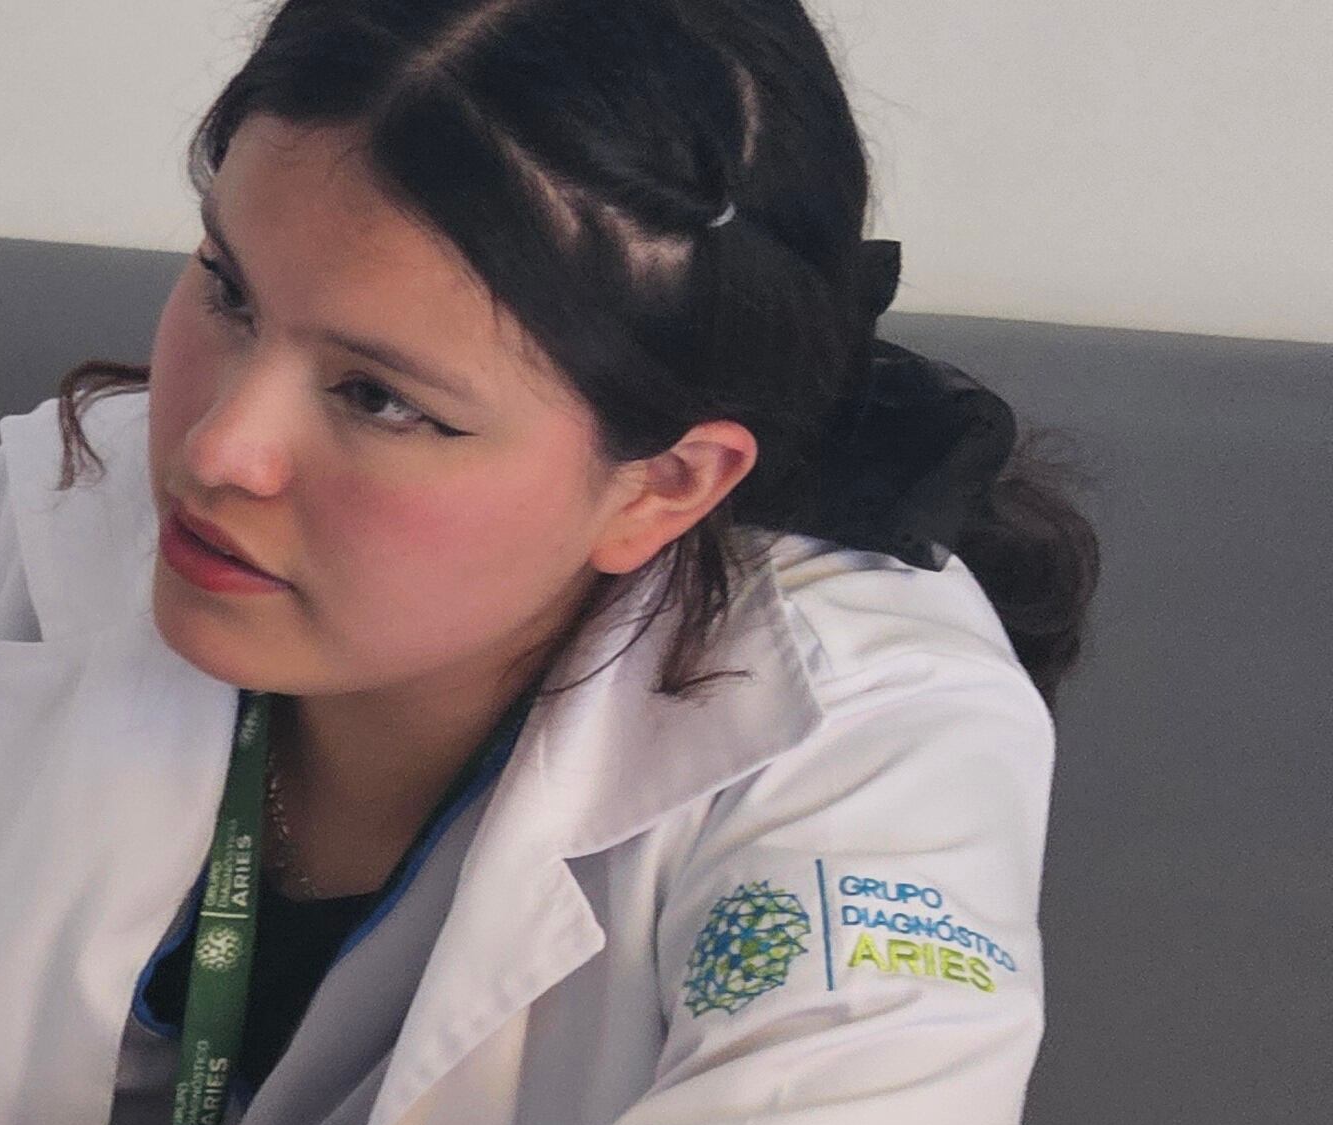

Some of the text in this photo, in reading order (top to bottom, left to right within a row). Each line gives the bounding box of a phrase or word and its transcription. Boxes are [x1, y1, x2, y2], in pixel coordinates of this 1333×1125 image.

[230, 833, 252, 908] ARIES
[838, 874, 943, 910] GRUPO
[840, 904, 1017, 973] DIAGNÓSTICO
[846, 932, 997, 994] ARIES
